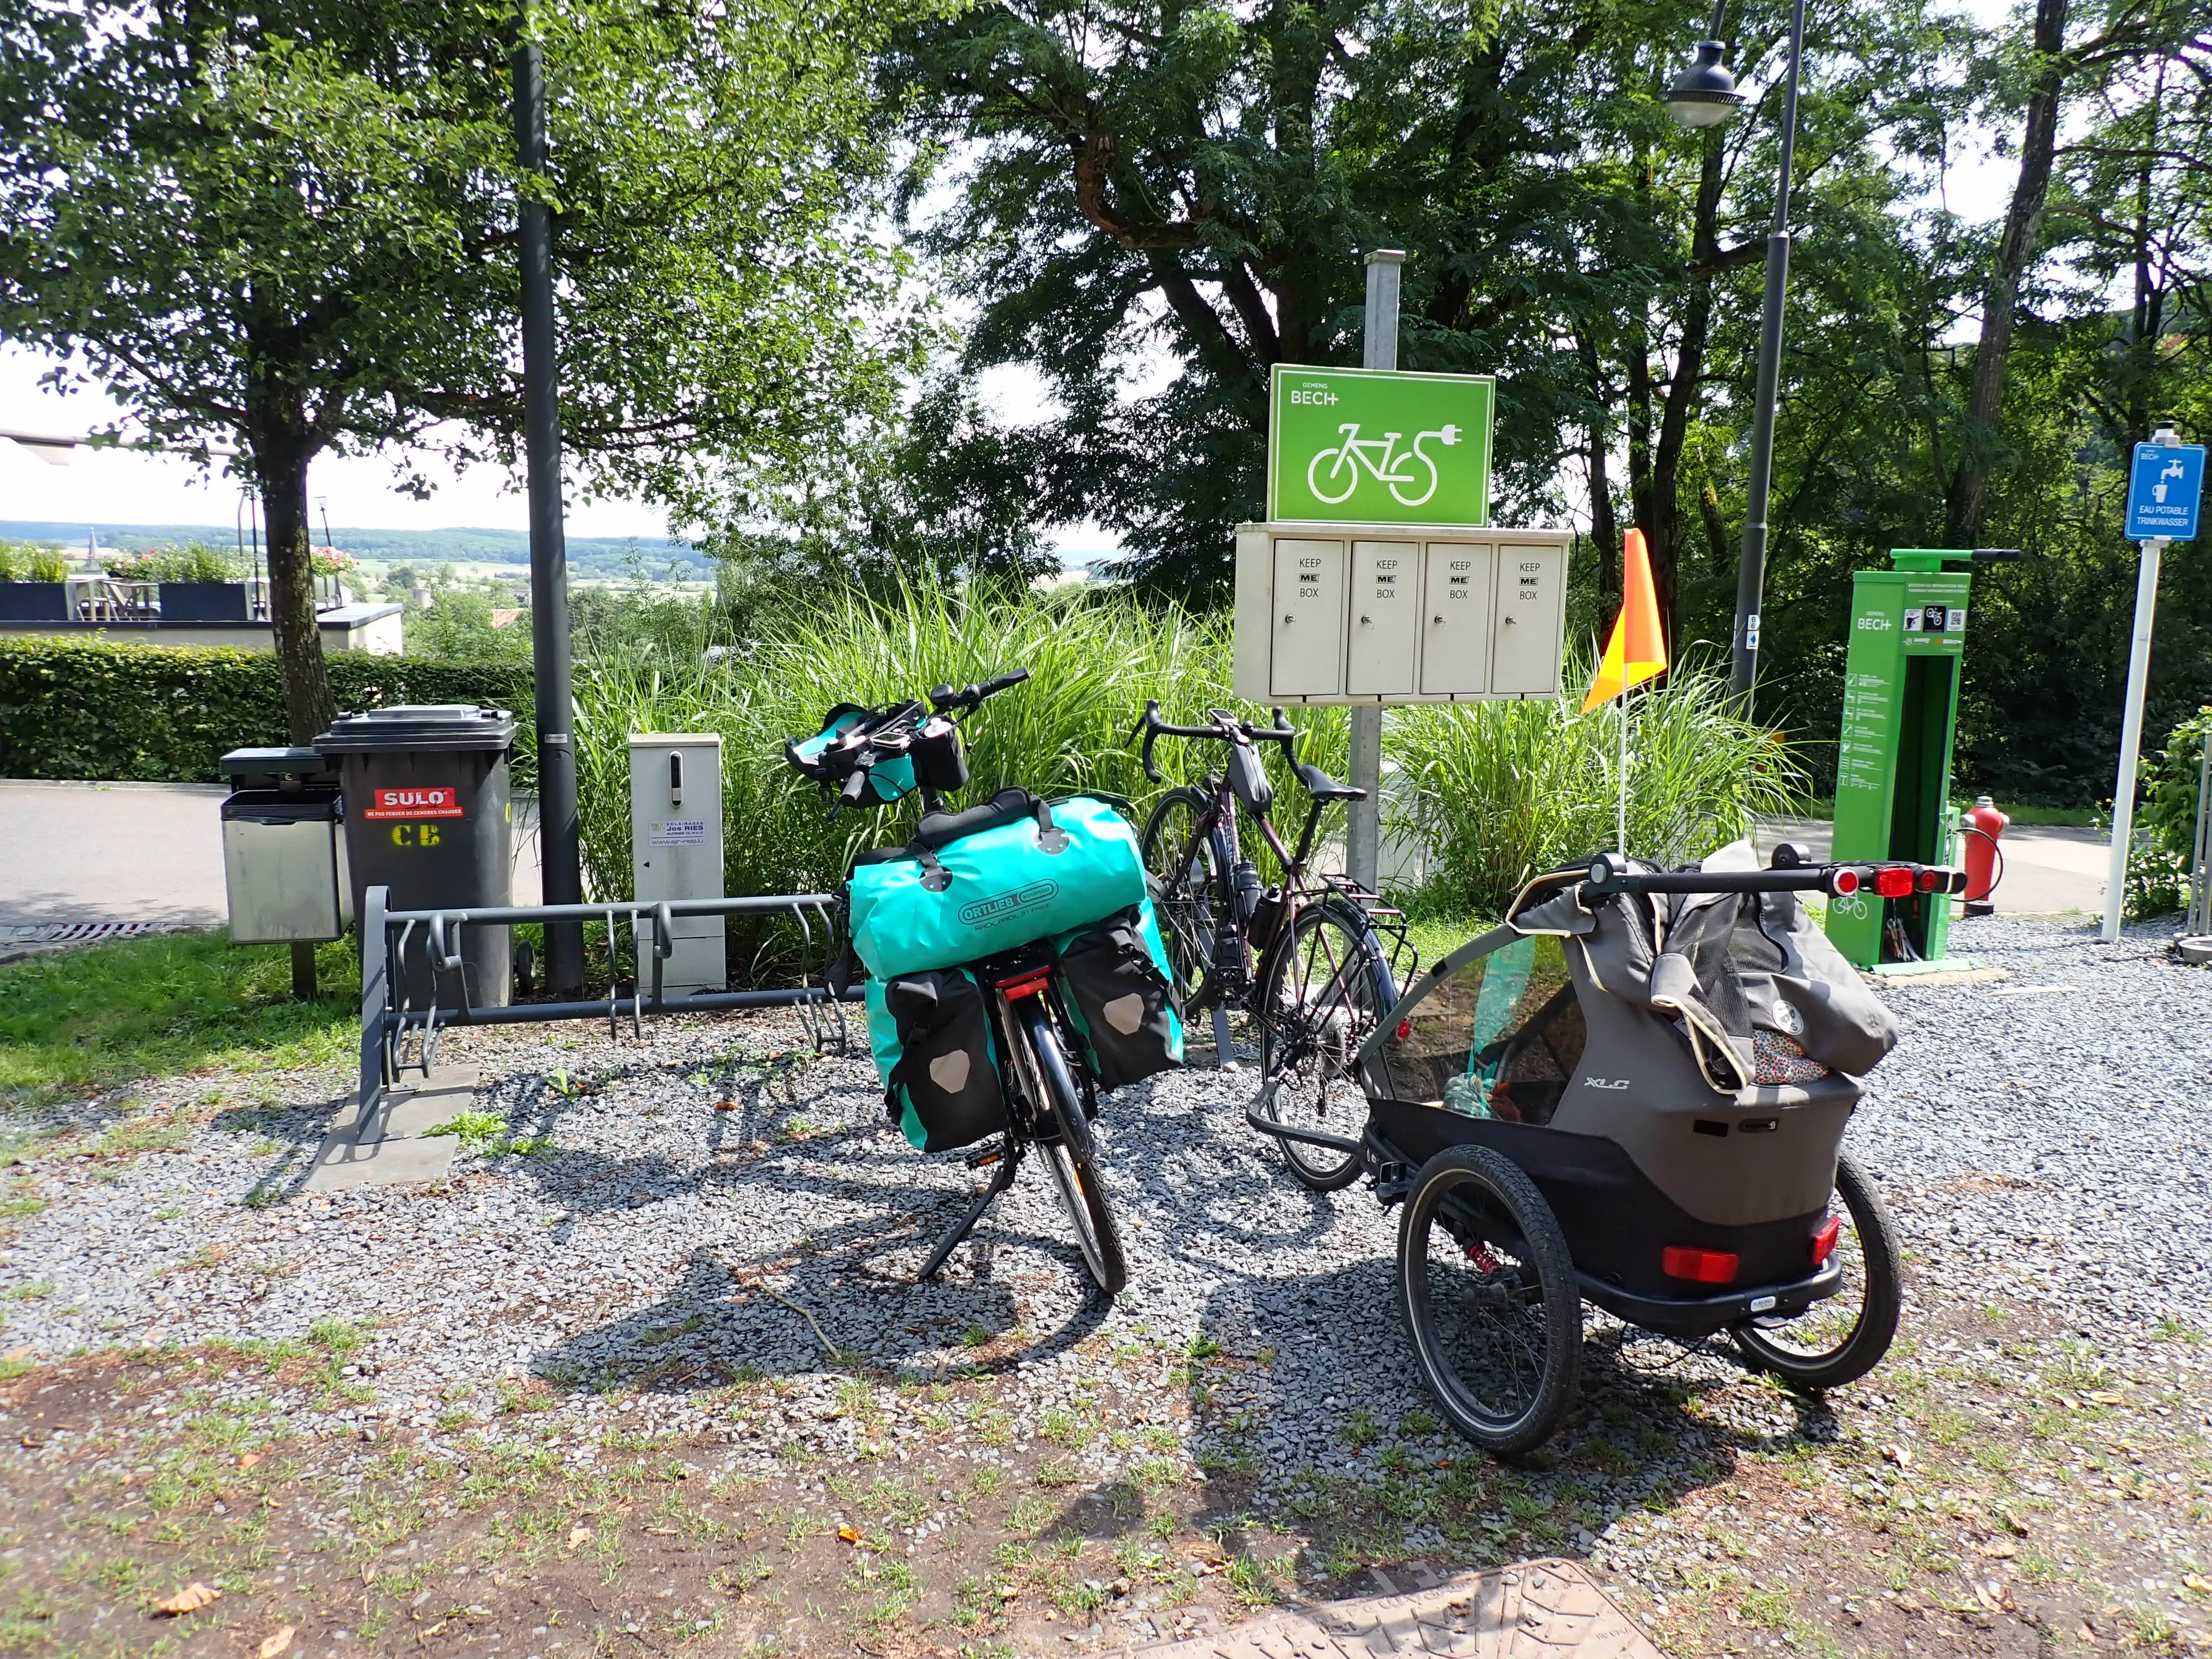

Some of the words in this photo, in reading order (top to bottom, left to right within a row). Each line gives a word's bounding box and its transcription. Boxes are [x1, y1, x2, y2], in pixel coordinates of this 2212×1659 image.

[2139, 505, 2154, 514] EAU
[2155, 506, 2189, 515] POTABLE
[2136, 517, 2188, 526] TRINKWASSER
[1300, 558, 1321, 567] KEEP
[1376, 560, 1397, 569] KEEP
[1450, 561, 1471, 570] KEEP
[1520, 563, 1540, 572] KEEP
[1300, 588, 1318, 597] BOX
[1376, 589, 1395, 598] BOX
[1450, 589, 1468, 599] BOX
[1520, 591, 1537, 600] BOX
[384, 791, 444, 806] SULO
[964, 897, 1015, 920] ORTLIEB
[1031, 903, 1051, 912] FREE
[1584, 1077, 1630, 1089] XLC
